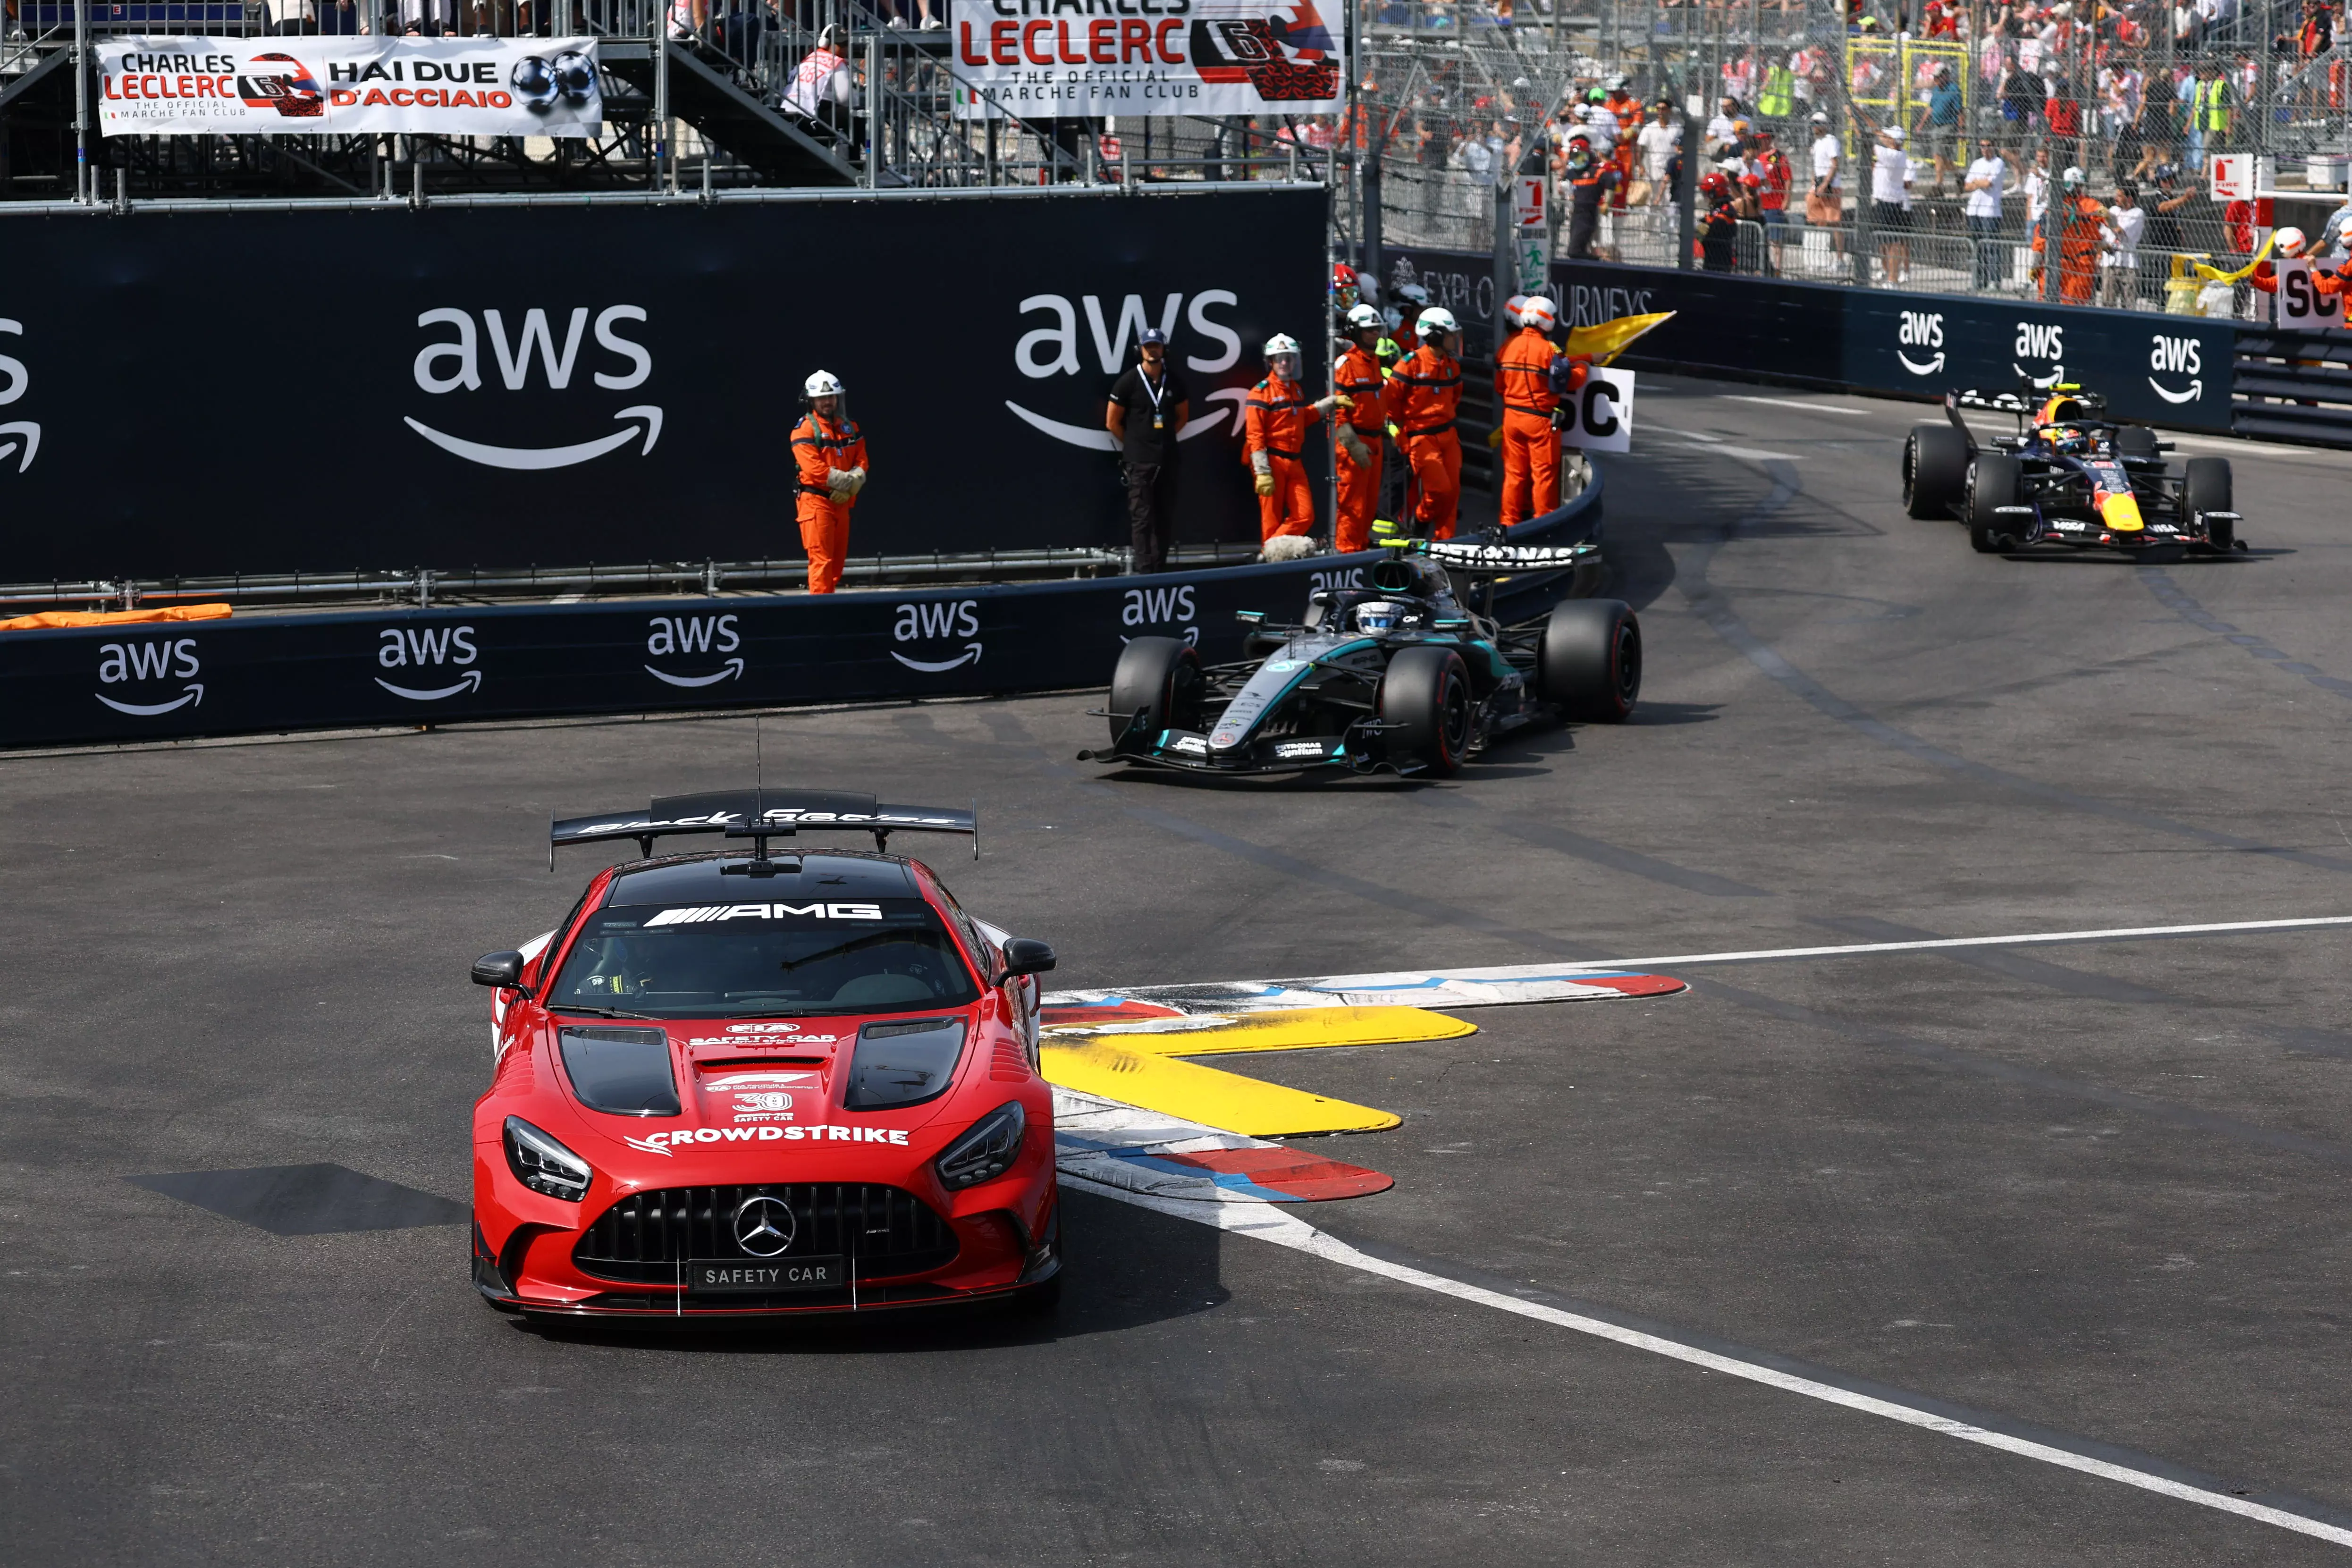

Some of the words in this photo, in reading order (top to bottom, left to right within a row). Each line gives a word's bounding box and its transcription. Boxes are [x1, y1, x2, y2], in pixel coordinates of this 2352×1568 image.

[961, 18, 1185, 66] LECLERC
[122, 52, 235, 74] CHARLES
[329, 61, 404, 82] HAI
[413, 61, 498, 84] DUE
[104, 74, 236, 100] LECLERC
[1012, 71, 1054, 84] THE
[1068, 70, 1170, 84] OFFICIAL
[330, 88, 512, 109] D'ACCIAIO
[983, 86, 1076, 101] MARCHE
[1091, 85, 1131, 99] FAN
[1144, 84, 1198, 98] CLUB
[121, 109, 174, 118] MARCHE
[182, 108, 206, 117] FAN
[214, 108, 246, 117] CLUB
[135, 101, 159, 109] THE
[167, 101, 227, 109] OFFICIAL
[2286, 269, 2337, 317] SC
[1549, 282, 1652, 328] URNEYS
[1015, 289, 1241, 378] aws
[1899, 311, 1943, 348] aws
[413, 304, 651, 394] aws
[2015, 322, 2063, 361] aws
[2151, 335, 2201, 375] aws
[2052, 521, 2086, 531] VISA
[2147, 524, 2180, 532] VISA
[1122, 585, 1195, 626] aws
[894, 600, 978, 641] aws
[648, 614, 740, 655] aws
[379, 626, 477, 667] aws
[99, 638, 199, 683] aws
[1276, 748, 1323, 758] Syntium
[717, 903, 883, 921] AMG
[689, 1035, 781, 1043] SAFETY
[731, 1024, 794, 1032] FIA
[732, 1092, 793, 1112] 30
[645, 1124, 909, 1146] CROWDSTRIKE
[706, 1269, 779, 1283] SAFETY
[789, 1266, 826, 1281] CAR
